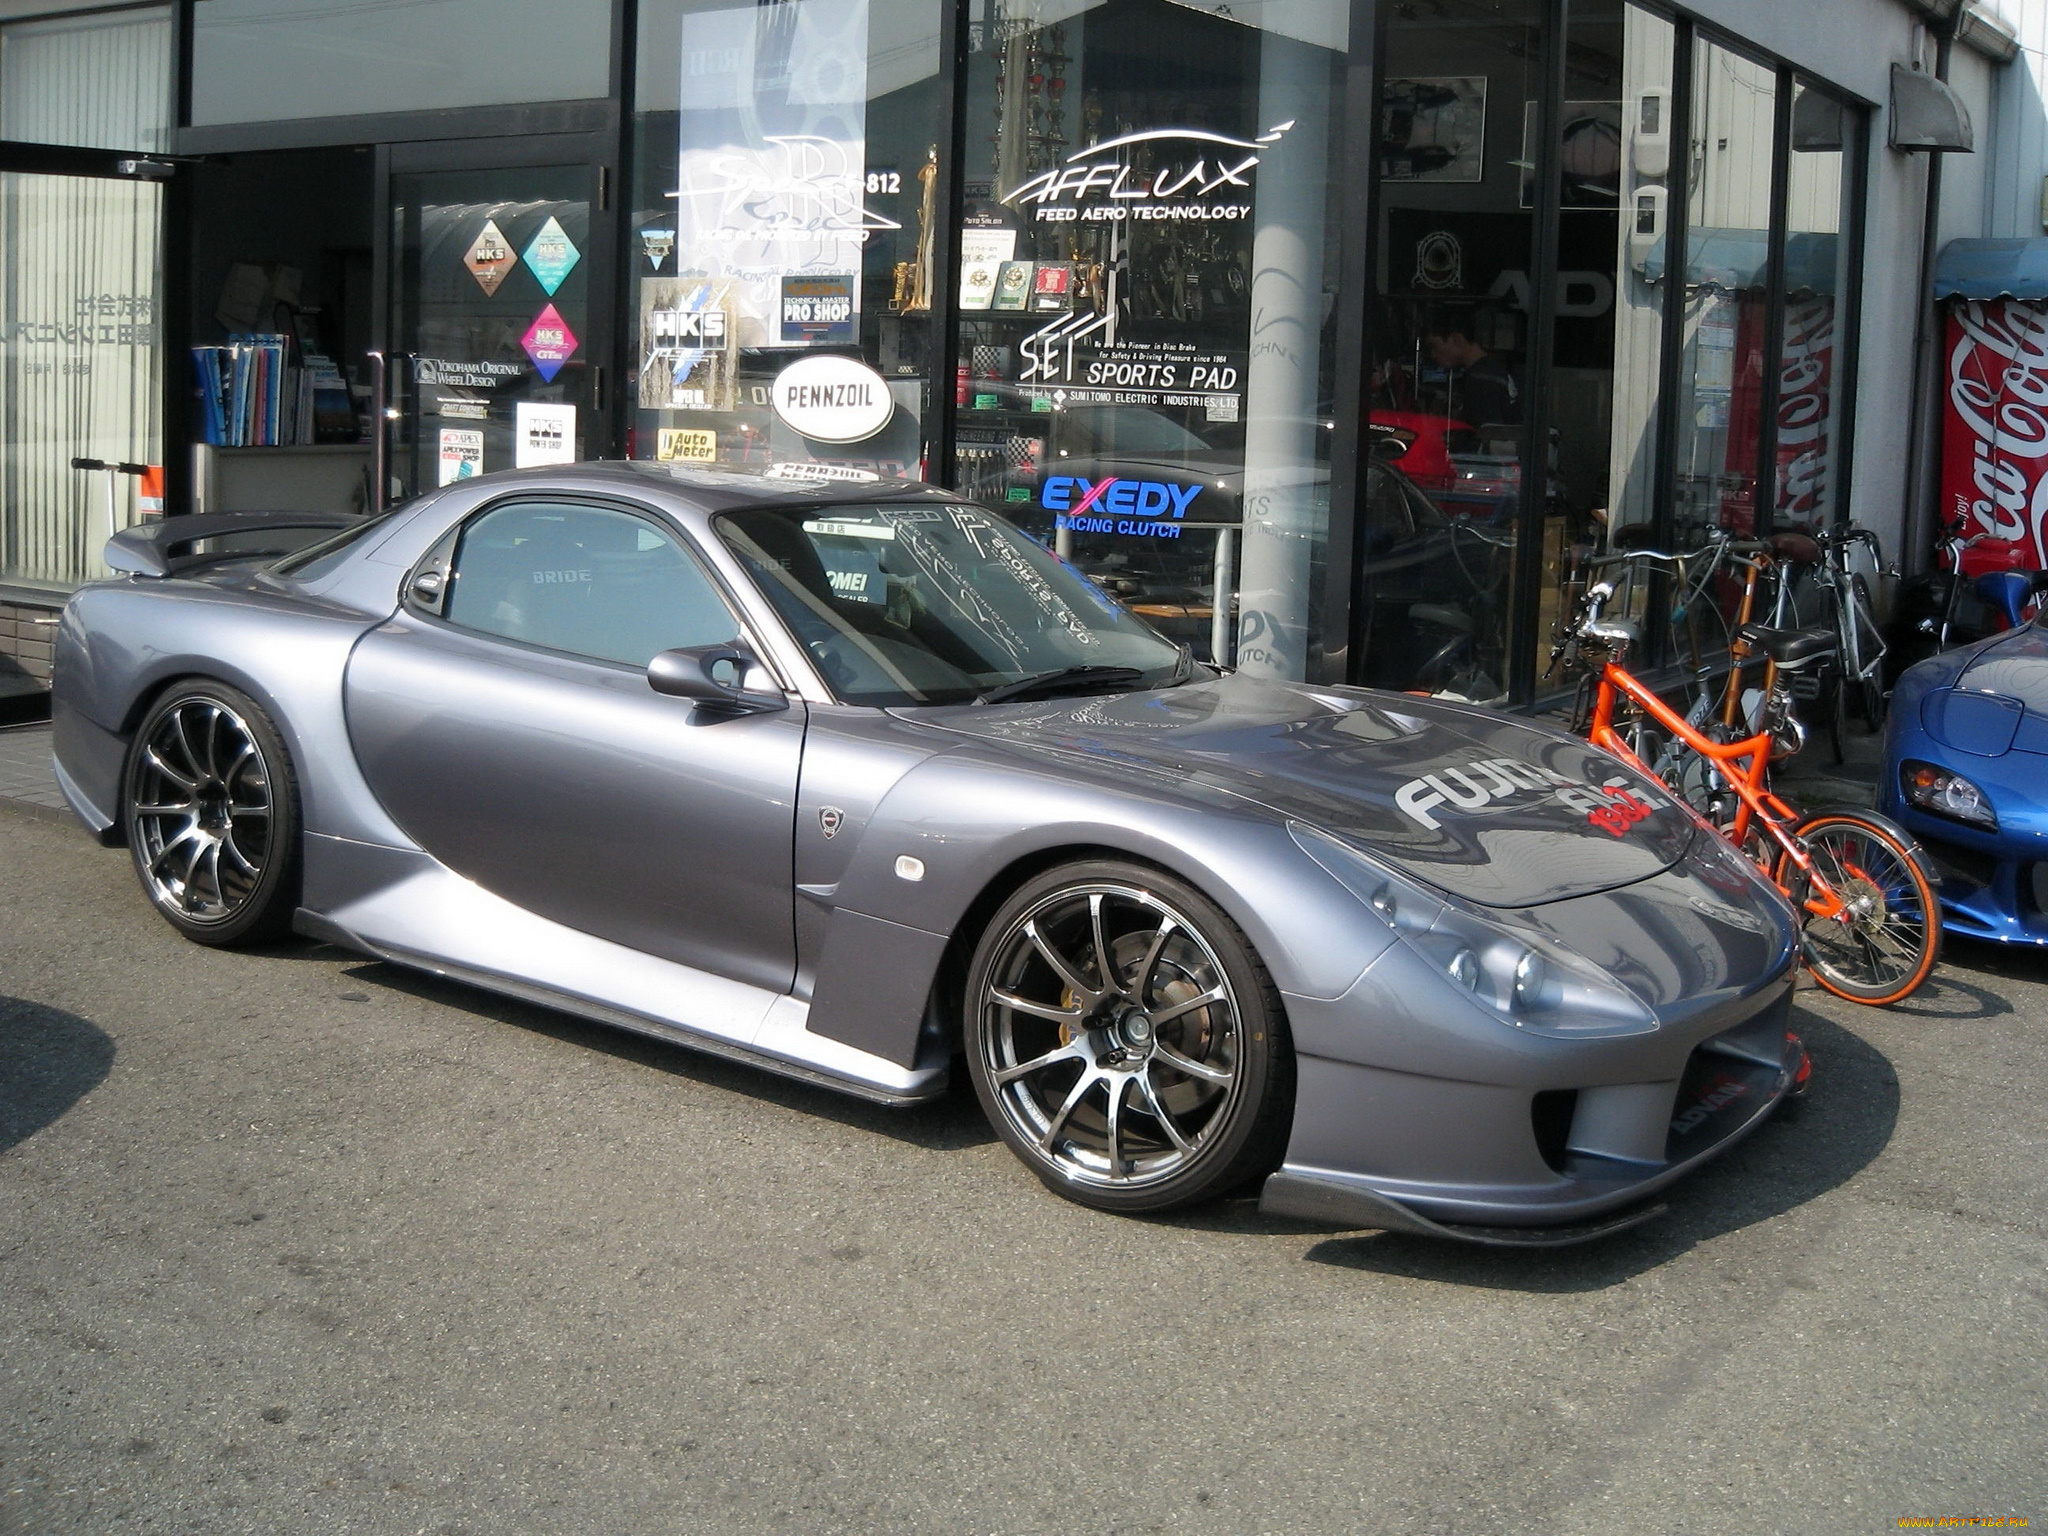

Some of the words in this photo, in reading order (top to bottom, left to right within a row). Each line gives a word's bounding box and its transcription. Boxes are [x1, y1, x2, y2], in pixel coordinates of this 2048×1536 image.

[1000, 157, 1260, 204] AFFLUX
[1036, 208, 1077, 221] FEED
[1081, 207, 1126, 221] AERO
[1132, 206, 1250, 220] TECHNOLOGY
[476, 249, 505, 262] HKS
[538, 243, 566, 256] HKS
[784, 304, 811, 321] PRO
[814, 304, 850, 321] SHOP
[655, 313, 724, 338] HKS
[536, 329, 564, 342] HKS
[1116, 341, 1127, 349] the
[1128, 341, 1151, 350] Pioneer
[1154, 342, 1161, 350] in
[1162, 342, 1177, 351] Disc
[1178, 342, 1196, 352] Brake
[1099, 351, 1109, 359] for
[1111, 352, 1130, 362] Safety
[1138, 353, 1162, 362] Driving
[1164, 353, 1191, 362] Pleasure
[1193, 354, 1211, 363] since
[437, 360, 480, 374] YOKOHAMA
[481, 361, 521, 375] ORIGINAL
[437, 372, 466, 386] WHEEL
[466, 373, 496, 387] DESIGN
[1086, 362, 1176, 388] SPORTS
[1189, 366, 1237, 390] PAD
[787, 384, 873, 408] PENNZOIL
[1069, 391, 1111, 402] SUMITOMO
[1115, 393, 1157, 405] ELECTRIC
[530, 418, 562, 438] HKS
[459, 434, 480, 444] APEX
[675, 432, 707, 445] Auto
[674, 444, 713, 458] Meter
[1042, 476, 1204, 519] EXEDY
[1055, 516, 1113, 533] RACING
[1117, 520, 1181, 539] CLUTCH
[533, 569, 592, 584] BRIDE
